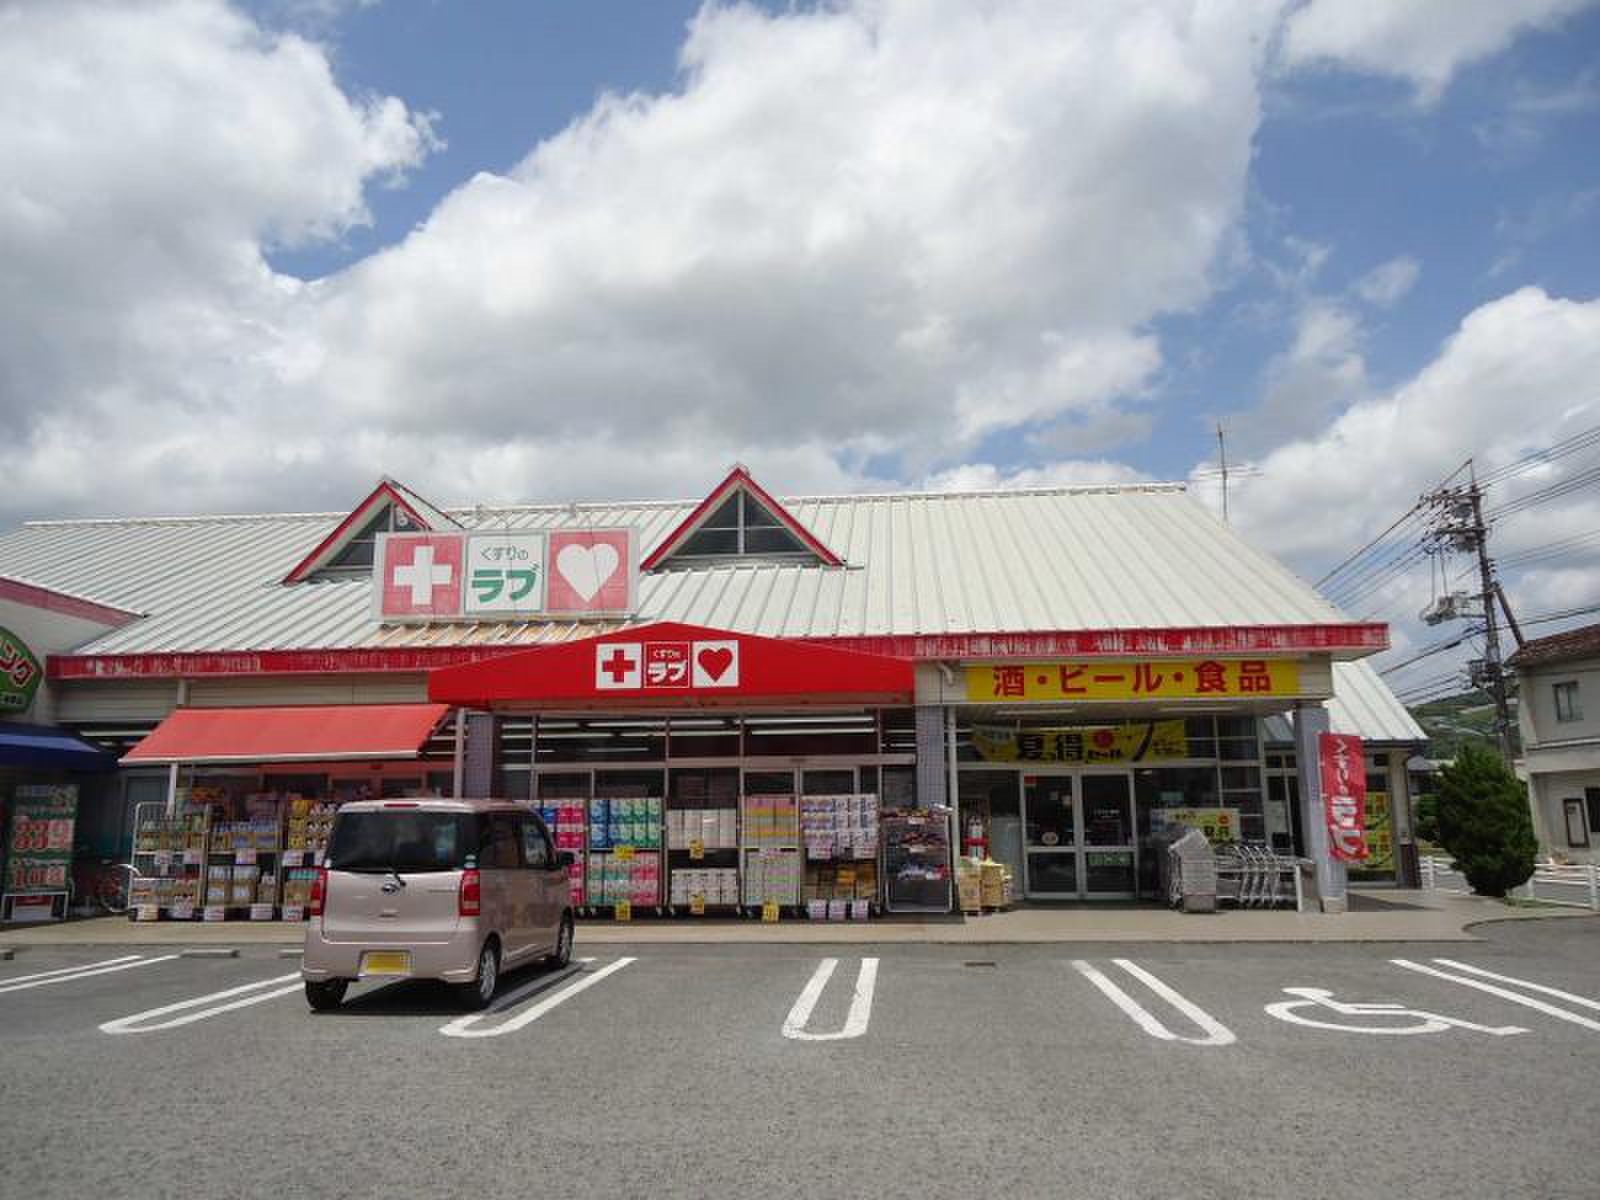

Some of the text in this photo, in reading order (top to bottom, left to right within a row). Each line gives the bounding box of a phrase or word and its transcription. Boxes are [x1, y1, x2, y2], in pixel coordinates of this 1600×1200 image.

[481, 544, 529, 561] くすりの
[472, 561, 543, 603] ラブ
[648, 660, 687, 683] ラブ
[992, 660, 1272, 697] 酒・ビール・食品
